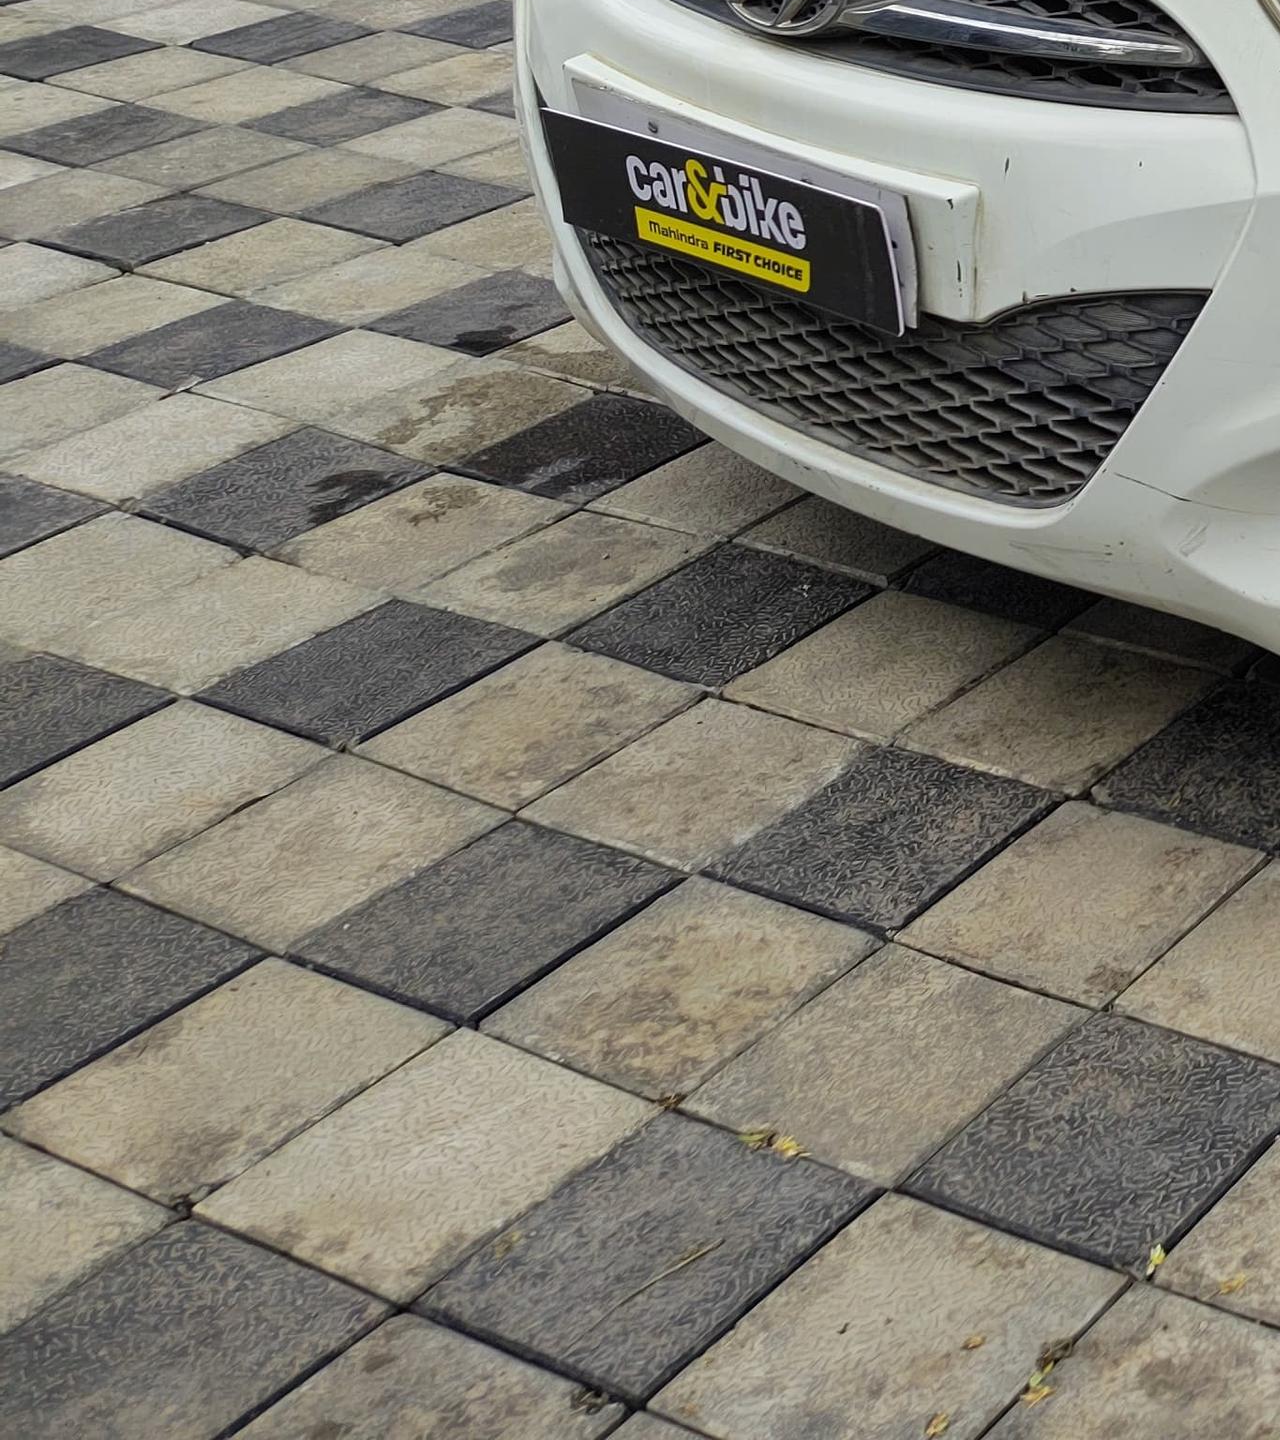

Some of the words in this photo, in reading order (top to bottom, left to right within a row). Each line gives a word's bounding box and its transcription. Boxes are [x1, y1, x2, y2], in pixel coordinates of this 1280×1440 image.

[625, 155, 807, 250] car&bike
[648, 220, 709, 250] Mahindra
[712, 241, 752, 264] FIRST
[753, 254, 803, 282] CHOICE
